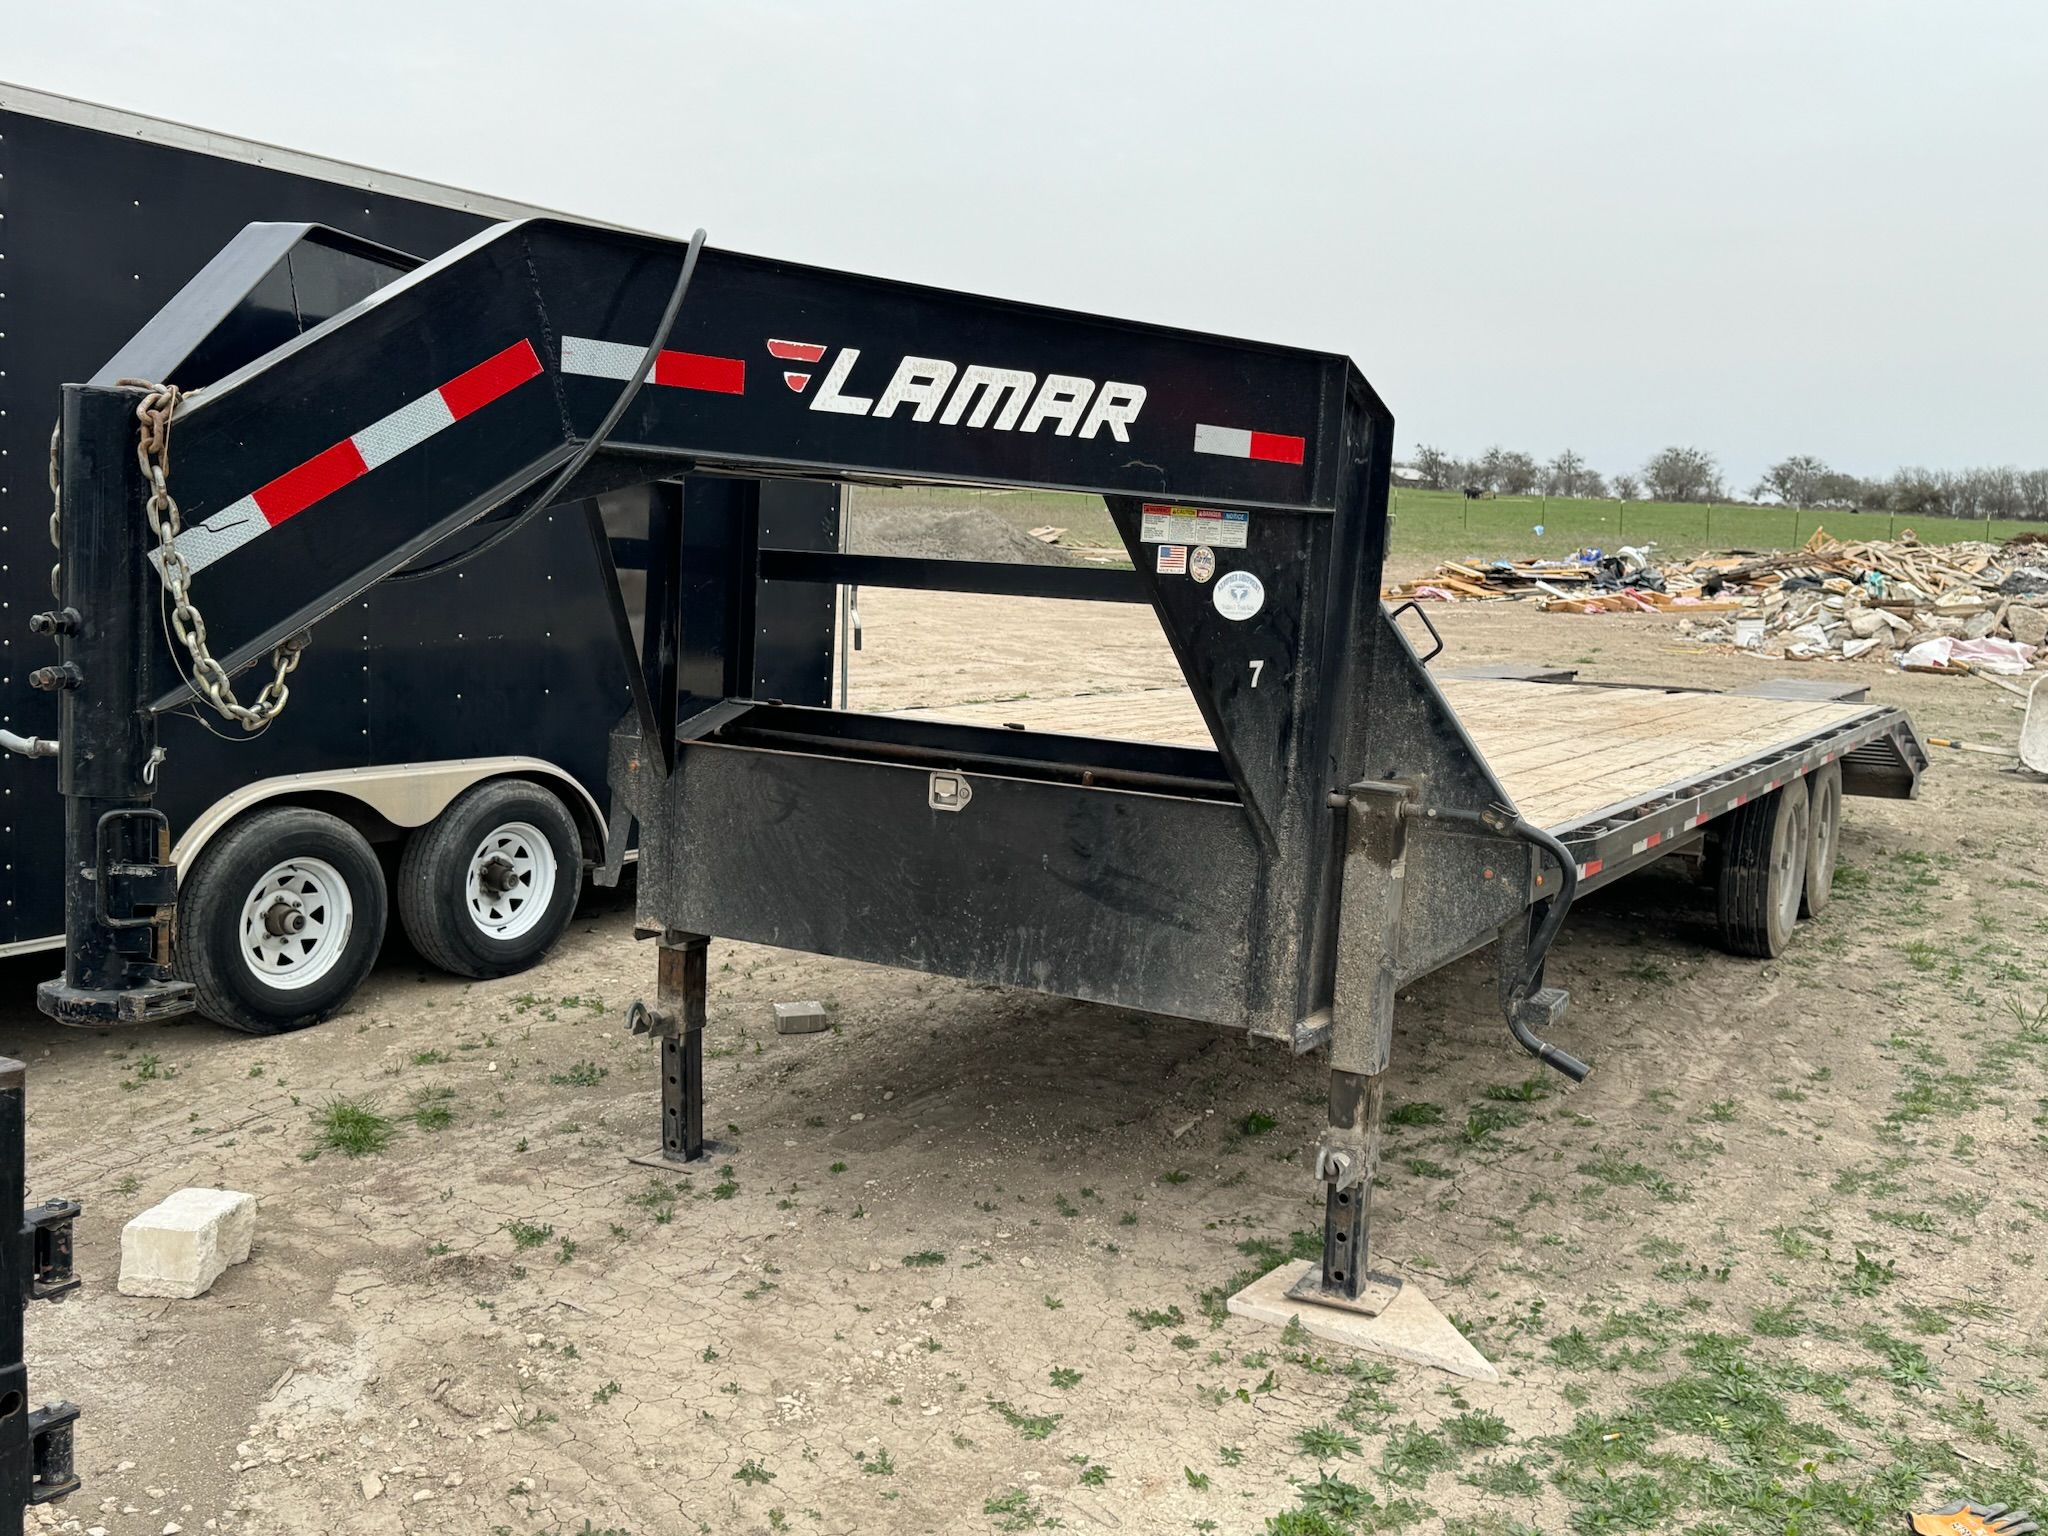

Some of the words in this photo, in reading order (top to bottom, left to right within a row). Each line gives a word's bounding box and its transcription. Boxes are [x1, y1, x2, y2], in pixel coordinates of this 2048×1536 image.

[809, 347, 1147, 443] LAMAR
[1226, 513, 1245, 521] NOTICE
[1249, 660, 1264, 688] 7
